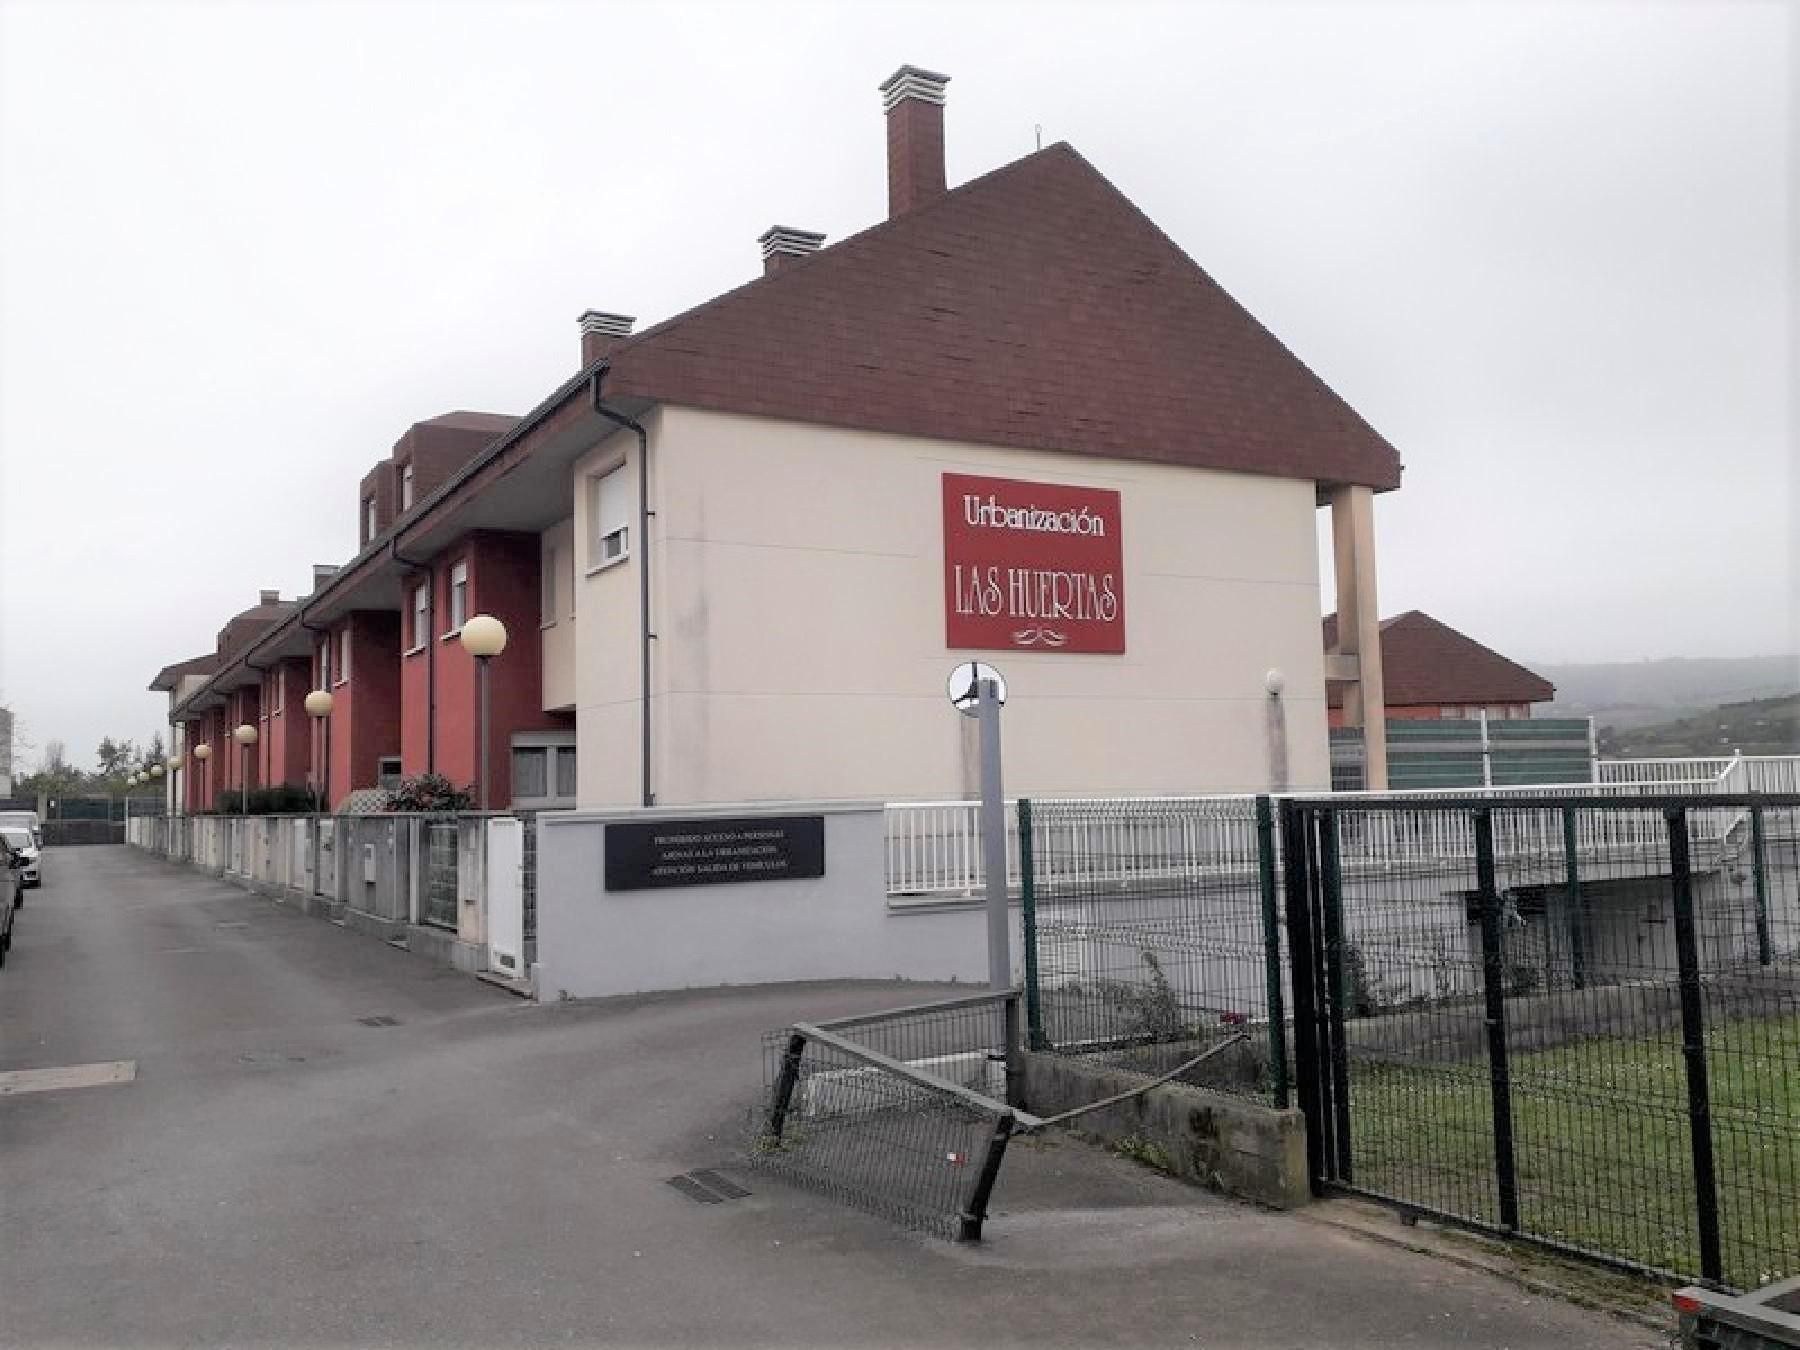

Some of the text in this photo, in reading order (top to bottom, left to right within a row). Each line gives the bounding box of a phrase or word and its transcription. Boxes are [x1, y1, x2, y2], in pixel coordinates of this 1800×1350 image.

[963, 494, 1105, 537] Urbanización
[955, 565, 1117, 622] LAS HUERTAS
